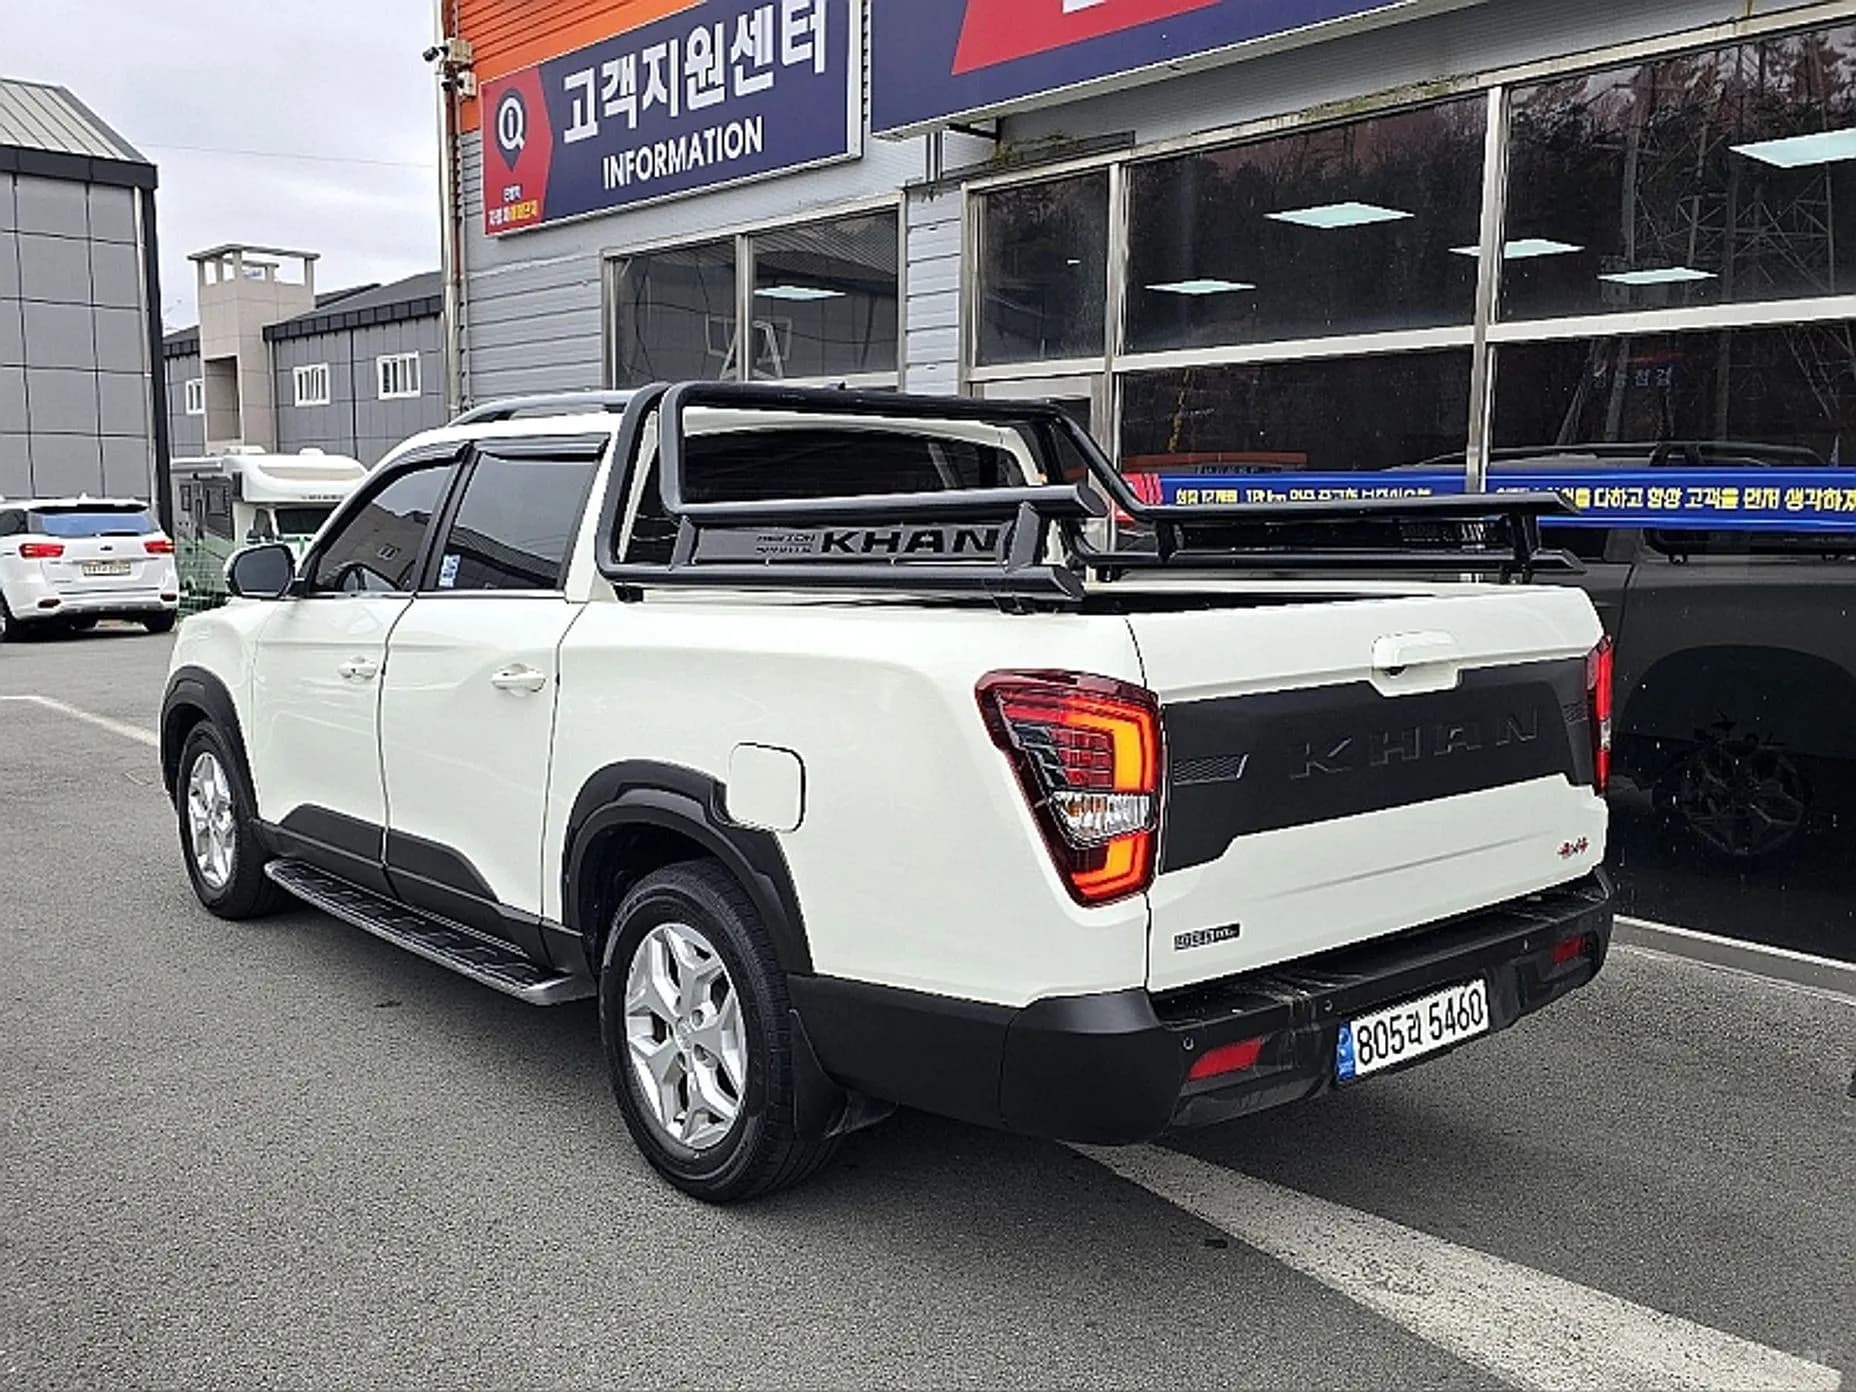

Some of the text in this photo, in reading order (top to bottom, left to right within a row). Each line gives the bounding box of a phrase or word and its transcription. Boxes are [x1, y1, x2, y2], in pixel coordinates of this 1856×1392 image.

[563, 0, 827, 144] 고객지원센터
[603, 115, 763, 189] INFORMATION
[1593, 486, 1643, 508] 다하고
[1647, 486, 1682, 509] 항상
[1684, 487, 1738, 510] 고객을
[821, 528, 1000, 553] KHAN
[1289, 704, 1538, 780] KHAN
[1428, 988, 1484, 1041] 5460
